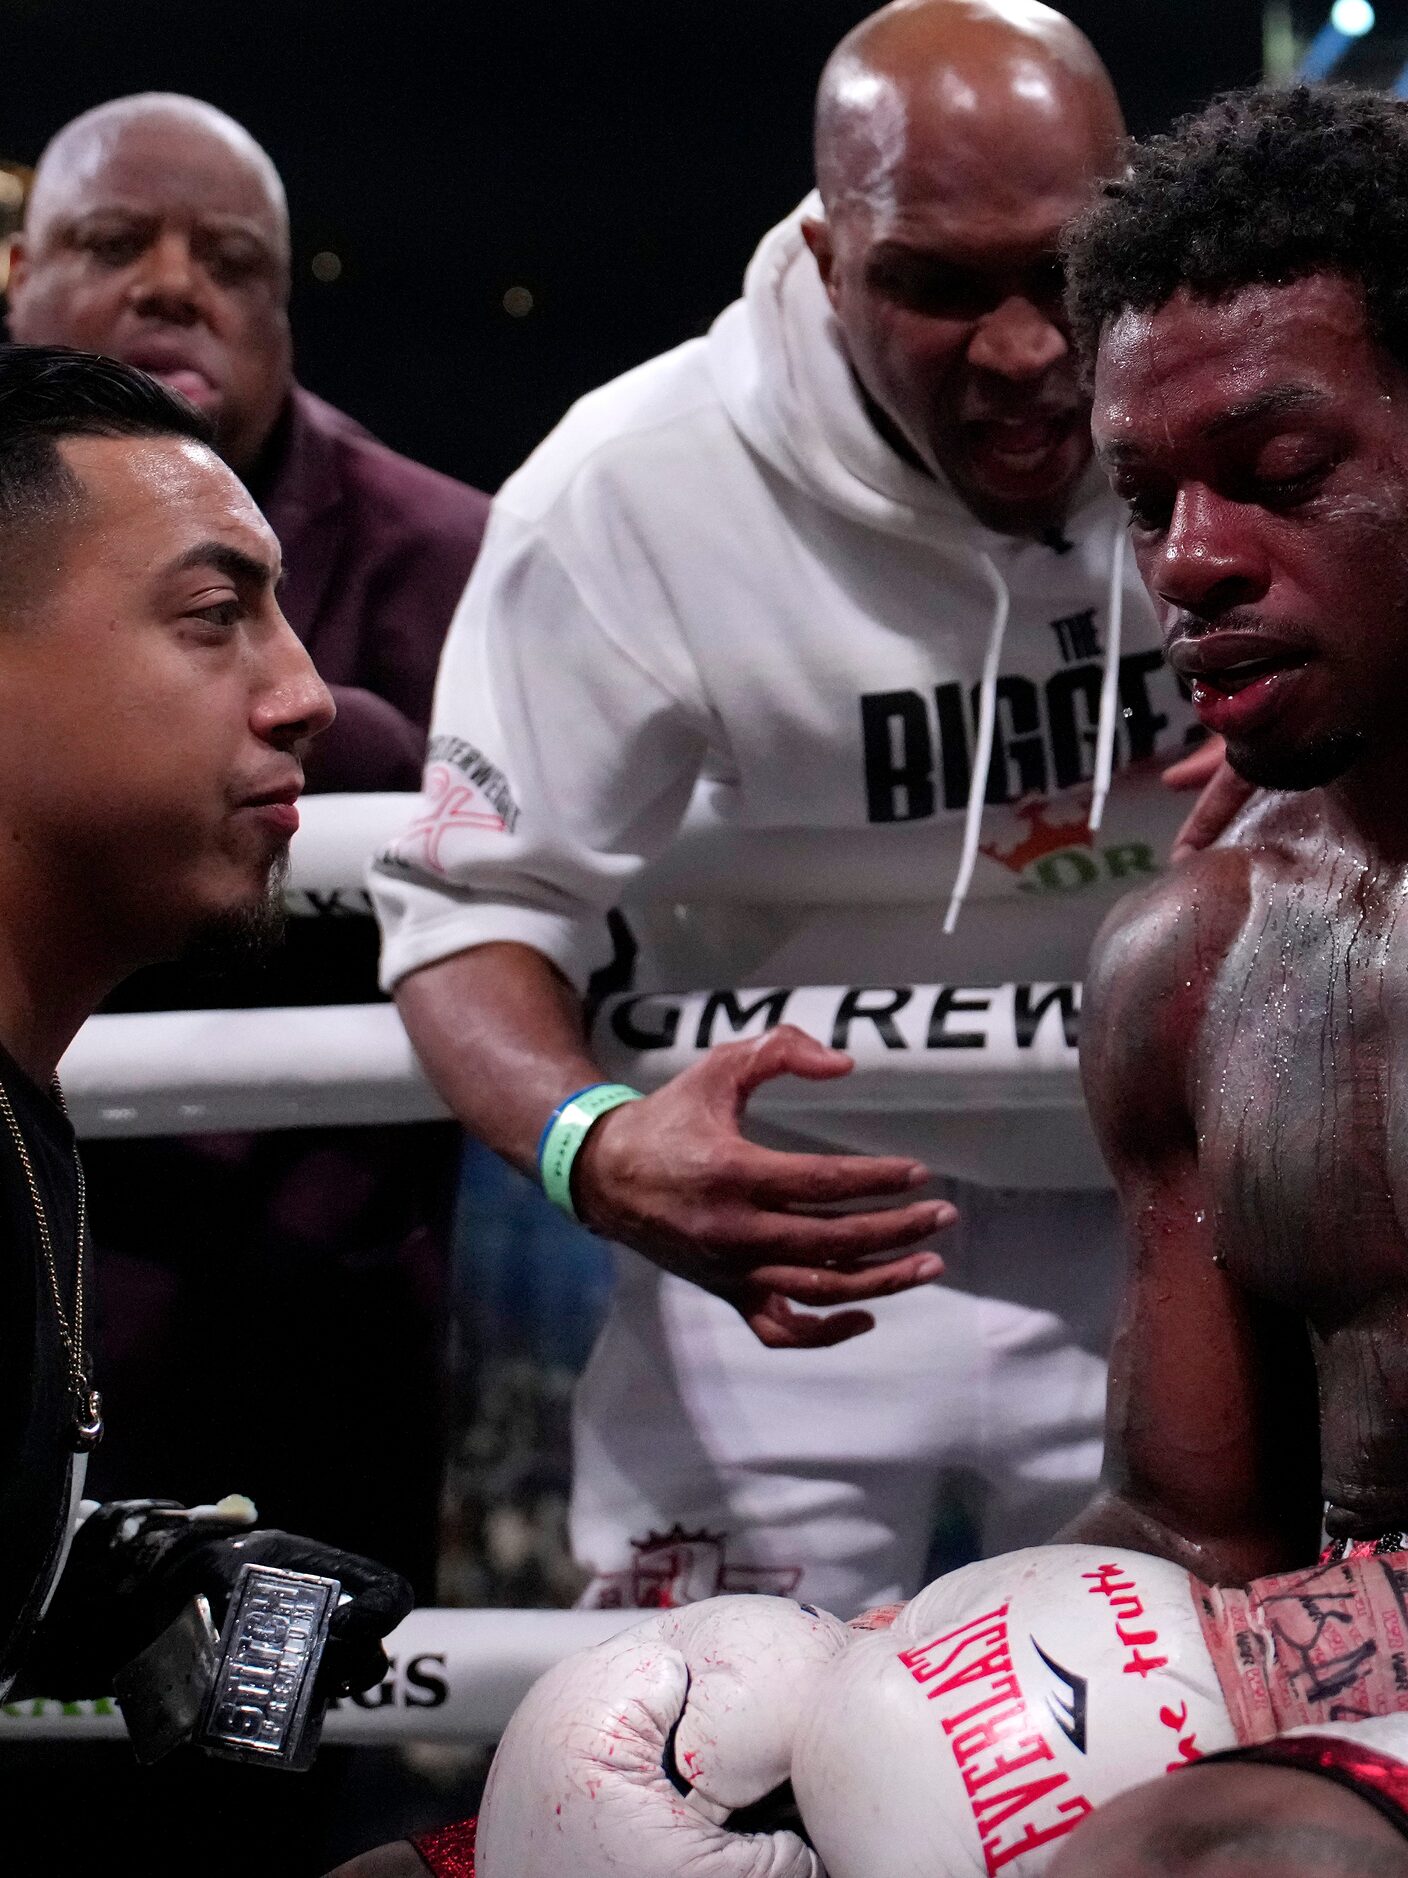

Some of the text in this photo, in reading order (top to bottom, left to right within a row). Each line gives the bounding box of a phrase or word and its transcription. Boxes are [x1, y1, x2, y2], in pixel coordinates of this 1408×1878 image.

[611, 984, 1081, 1050] GM REW
[1081, 1562, 1169, 1679] truth
[898, 1601, 1094, 1878] EVERLAST
